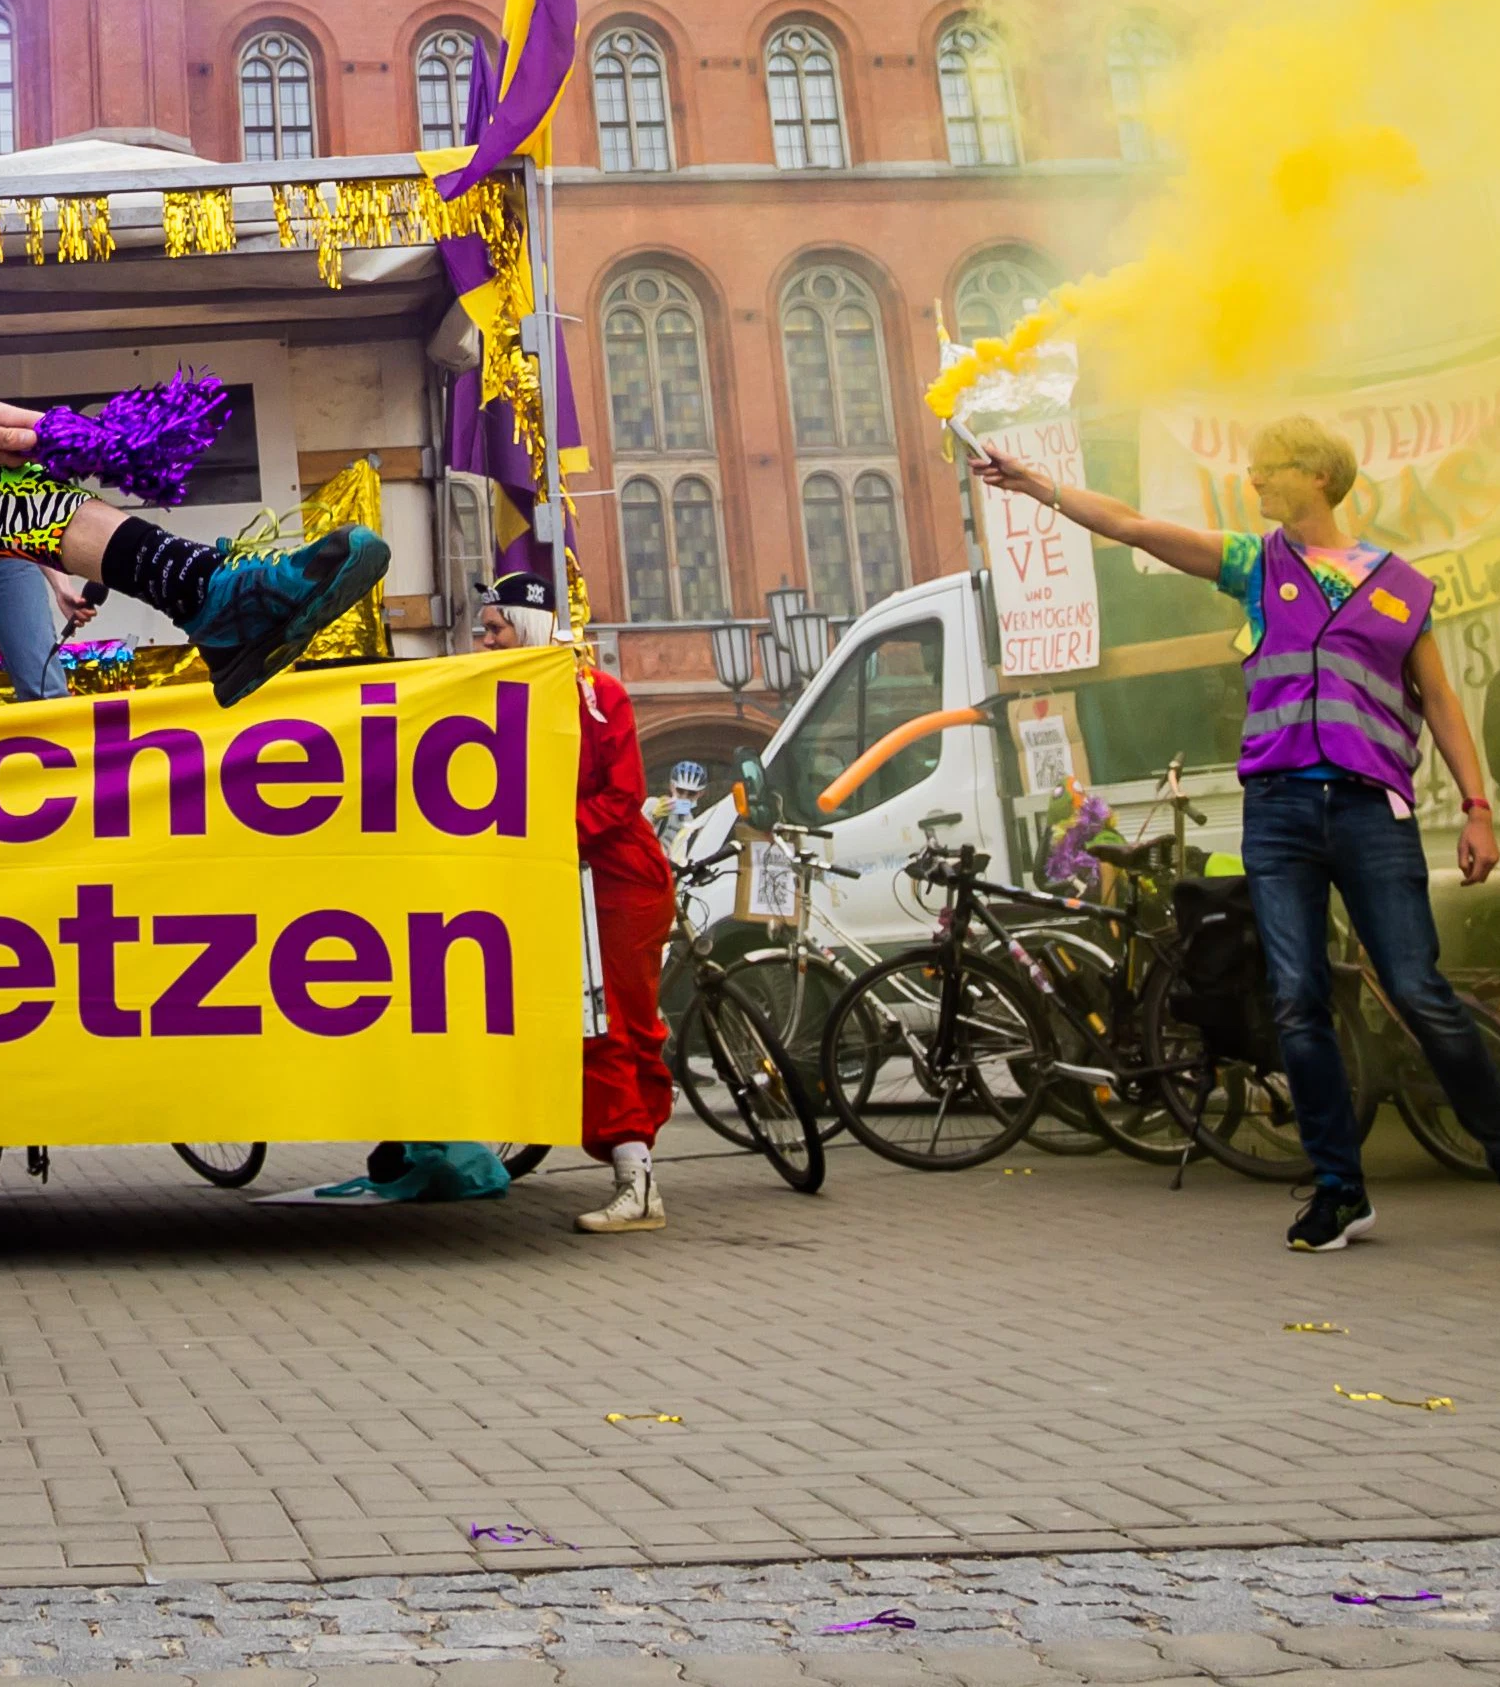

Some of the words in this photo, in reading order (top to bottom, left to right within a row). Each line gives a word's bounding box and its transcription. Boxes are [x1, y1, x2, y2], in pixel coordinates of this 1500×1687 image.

[1035, 421, 1078, 456] YOU
[1006, 532, 1069, 583] VE
[1025, 586, 1053, 602] UND
[1004, 629, 1093, 673] STEUER!
